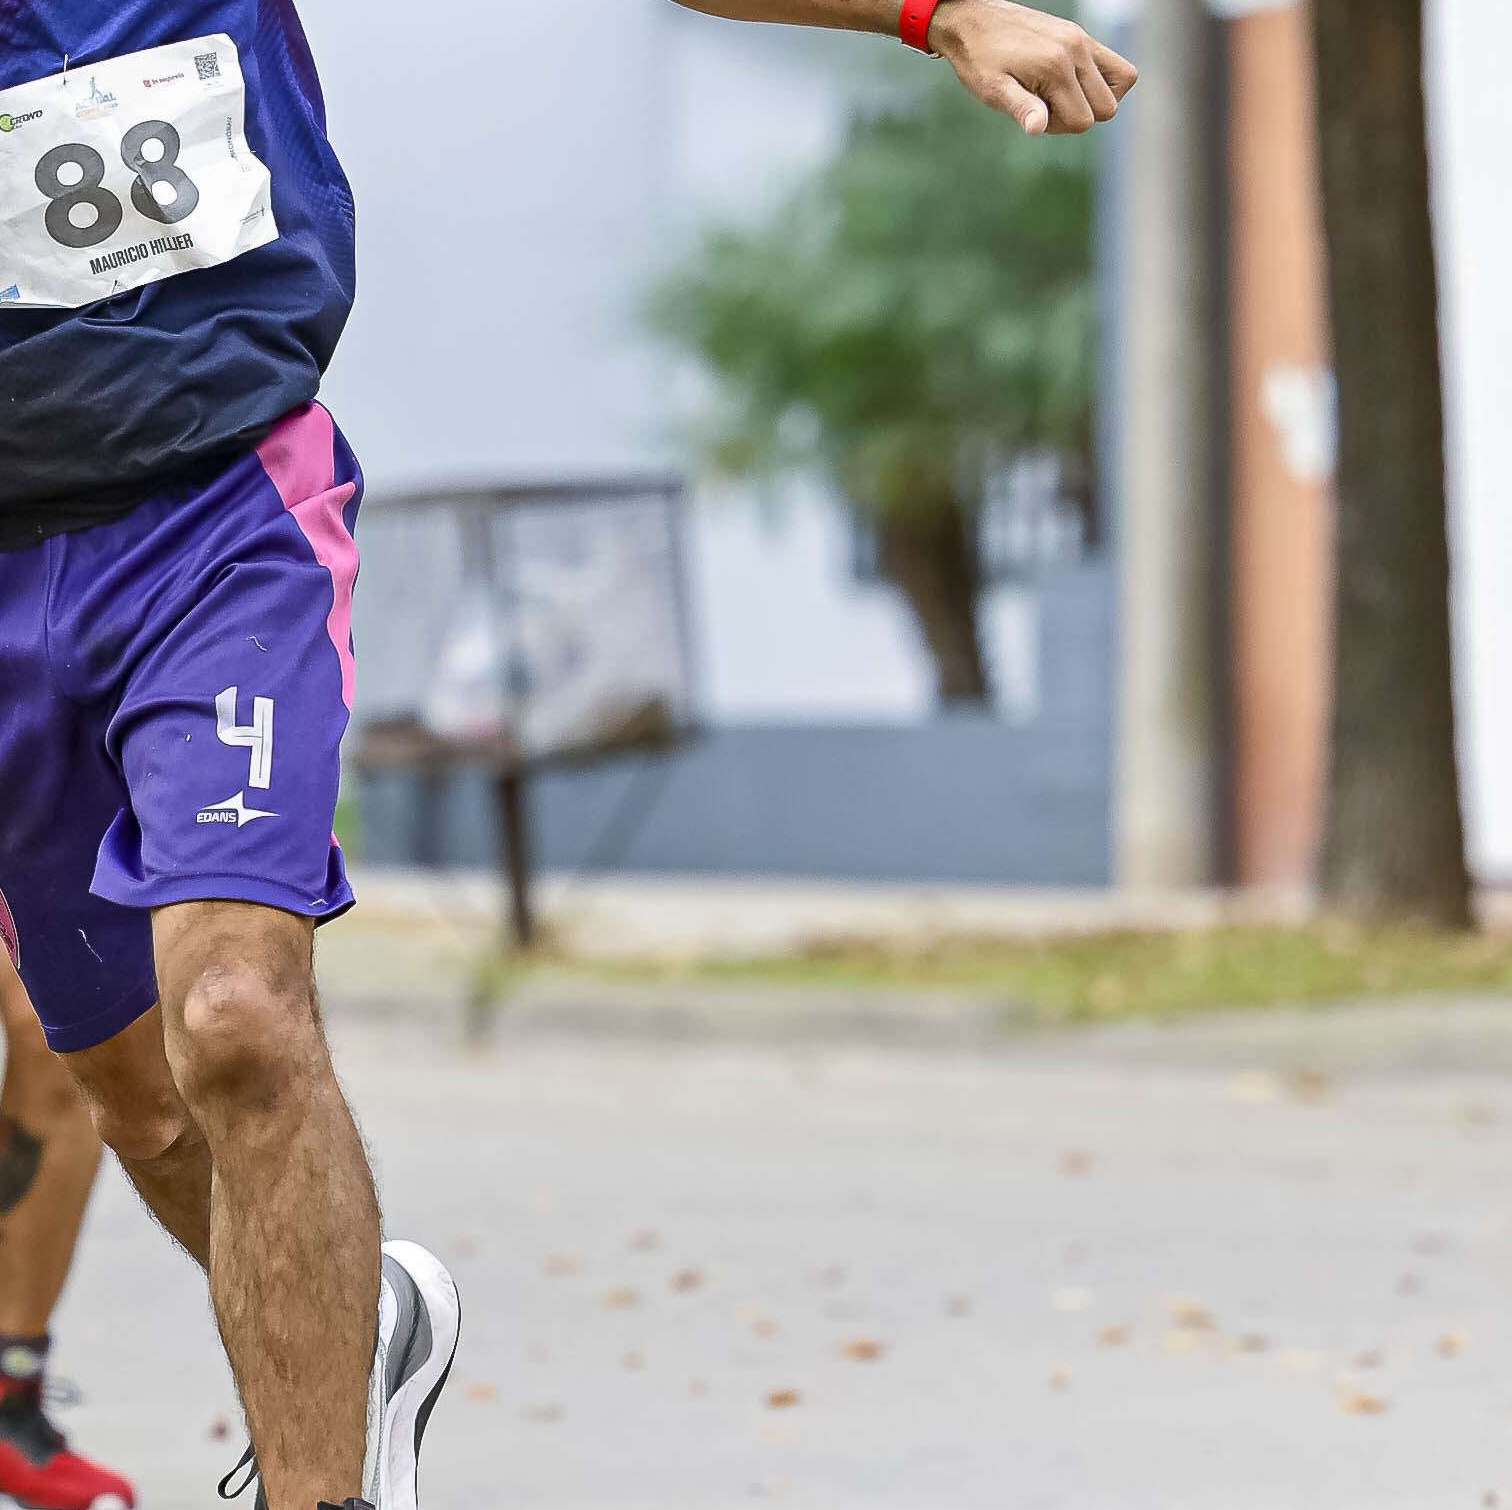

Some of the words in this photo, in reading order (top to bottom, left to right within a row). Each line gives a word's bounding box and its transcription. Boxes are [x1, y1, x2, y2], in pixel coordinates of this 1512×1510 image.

[34, 119, 200, 249] 88
[90, 243, 150, 275] MAURICIO
[146, 232, 194, 261] HILLIER
[214, 684, 275, 790] 4
[196, 811, 237, 823] EDANS
